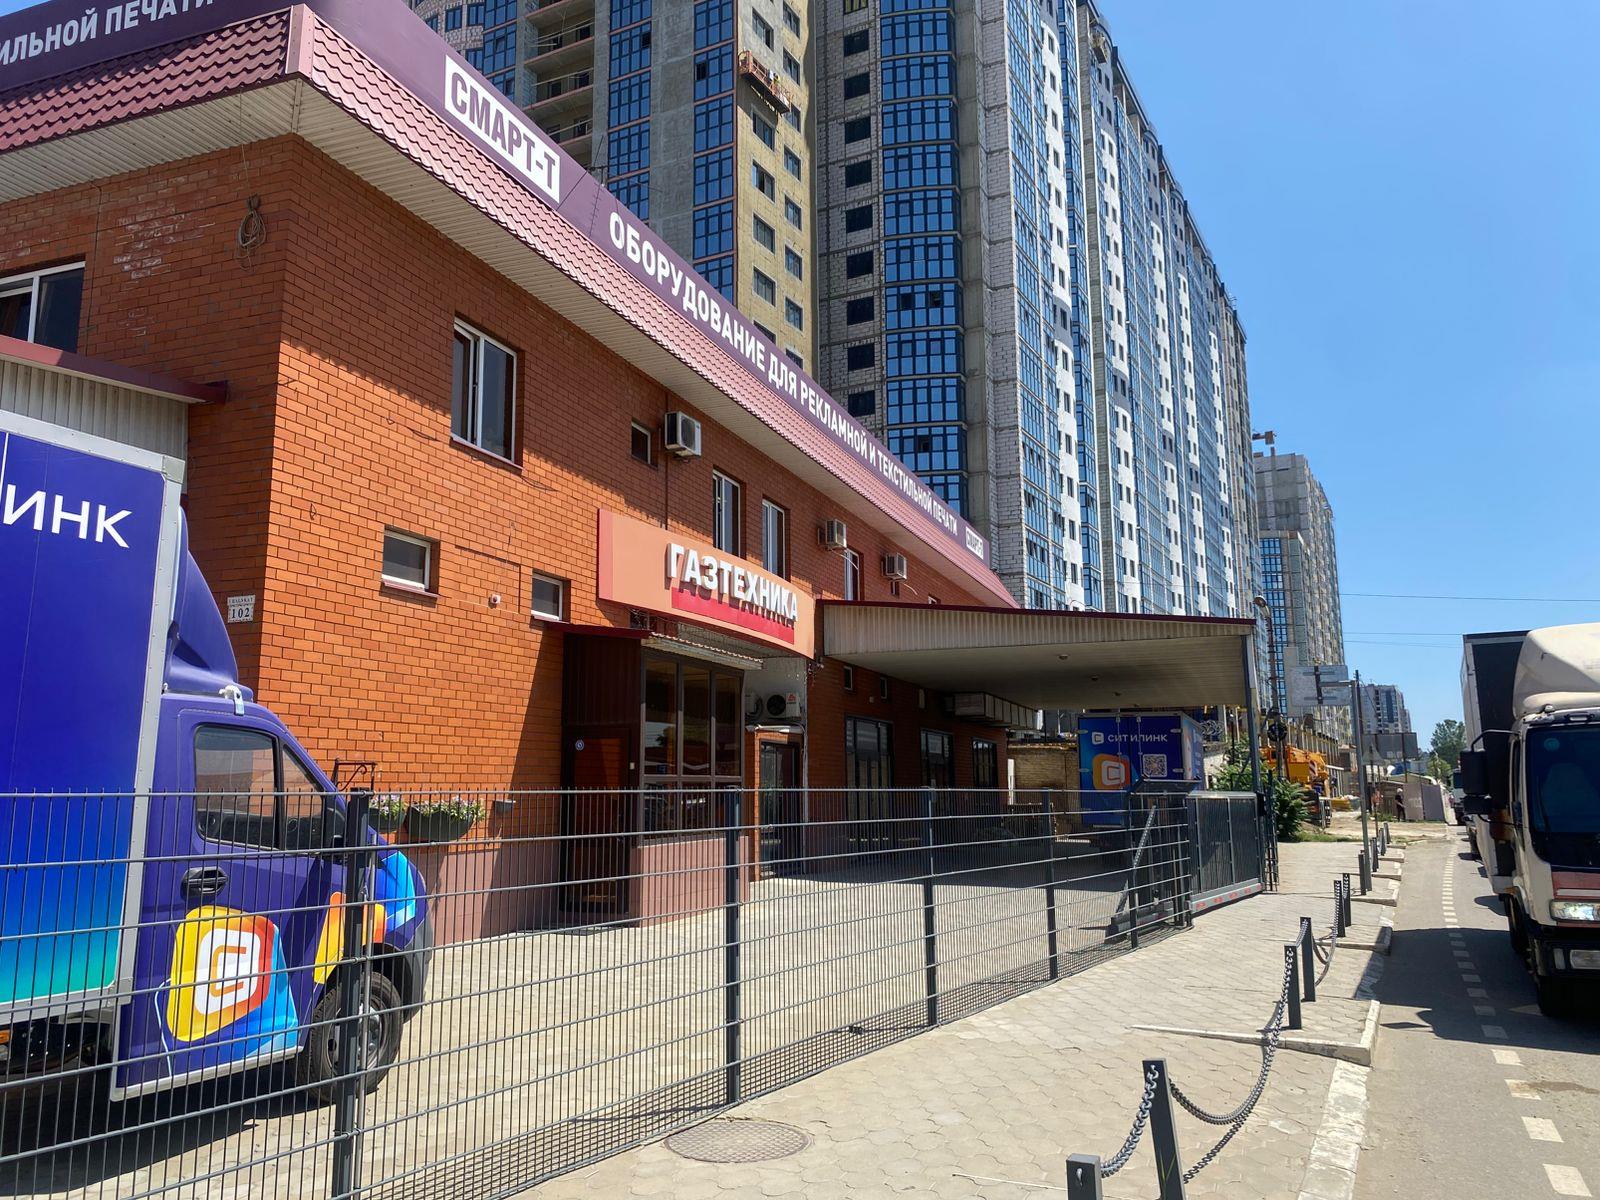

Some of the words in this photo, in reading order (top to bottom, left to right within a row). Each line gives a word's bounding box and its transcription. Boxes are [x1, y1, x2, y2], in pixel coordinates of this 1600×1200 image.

[104, 0, 213, 35] ПЕЧА
[450, 71, 556, 190] СМАРТ-Т
[609, 212, 765, 372] ОБОРУДОВАНИЕ
[768, 354, 797, 399] ДЛЯ
[800, 380, 867, 461] РЕКЛАМНОЙ
[869, 443, 876, 467] И
[877, 450, 933, 516] ТЕКСТИЛЬНОЙ
[933, 500, 958, 536] ПЕЧАТИ
[3, 484, 132, 548] ИНК
[231, 607, 250, 619] 102
[667, 542, 798, 622] ГАЗТЕХНИКА
